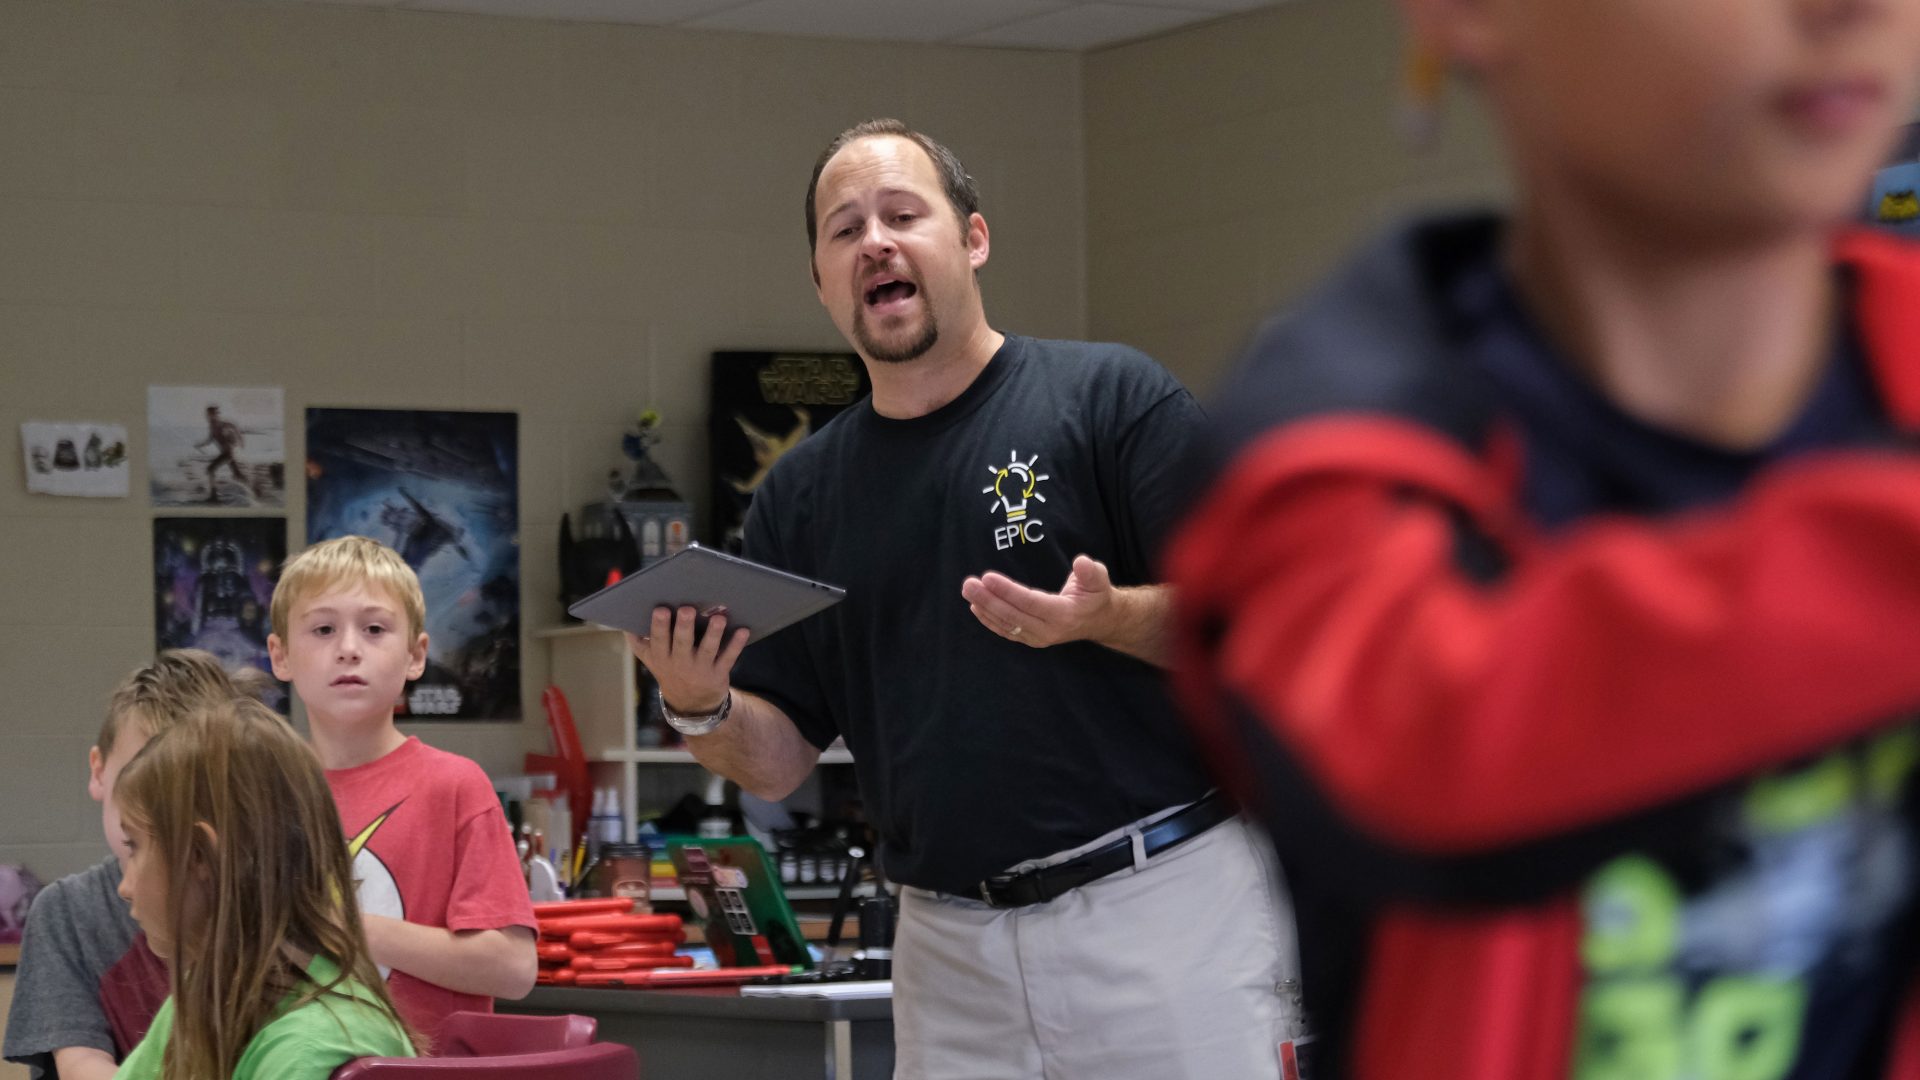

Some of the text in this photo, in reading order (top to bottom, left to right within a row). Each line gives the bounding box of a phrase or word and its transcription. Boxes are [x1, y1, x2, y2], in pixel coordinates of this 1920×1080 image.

[758, 357, 857, 381] STAR
[760, 380, 858, 405] WARS
[994, 519, 1045, 551] EPIC
[409, 687, 462, 702] STAR
[409, 701, 461, 715] WARS
